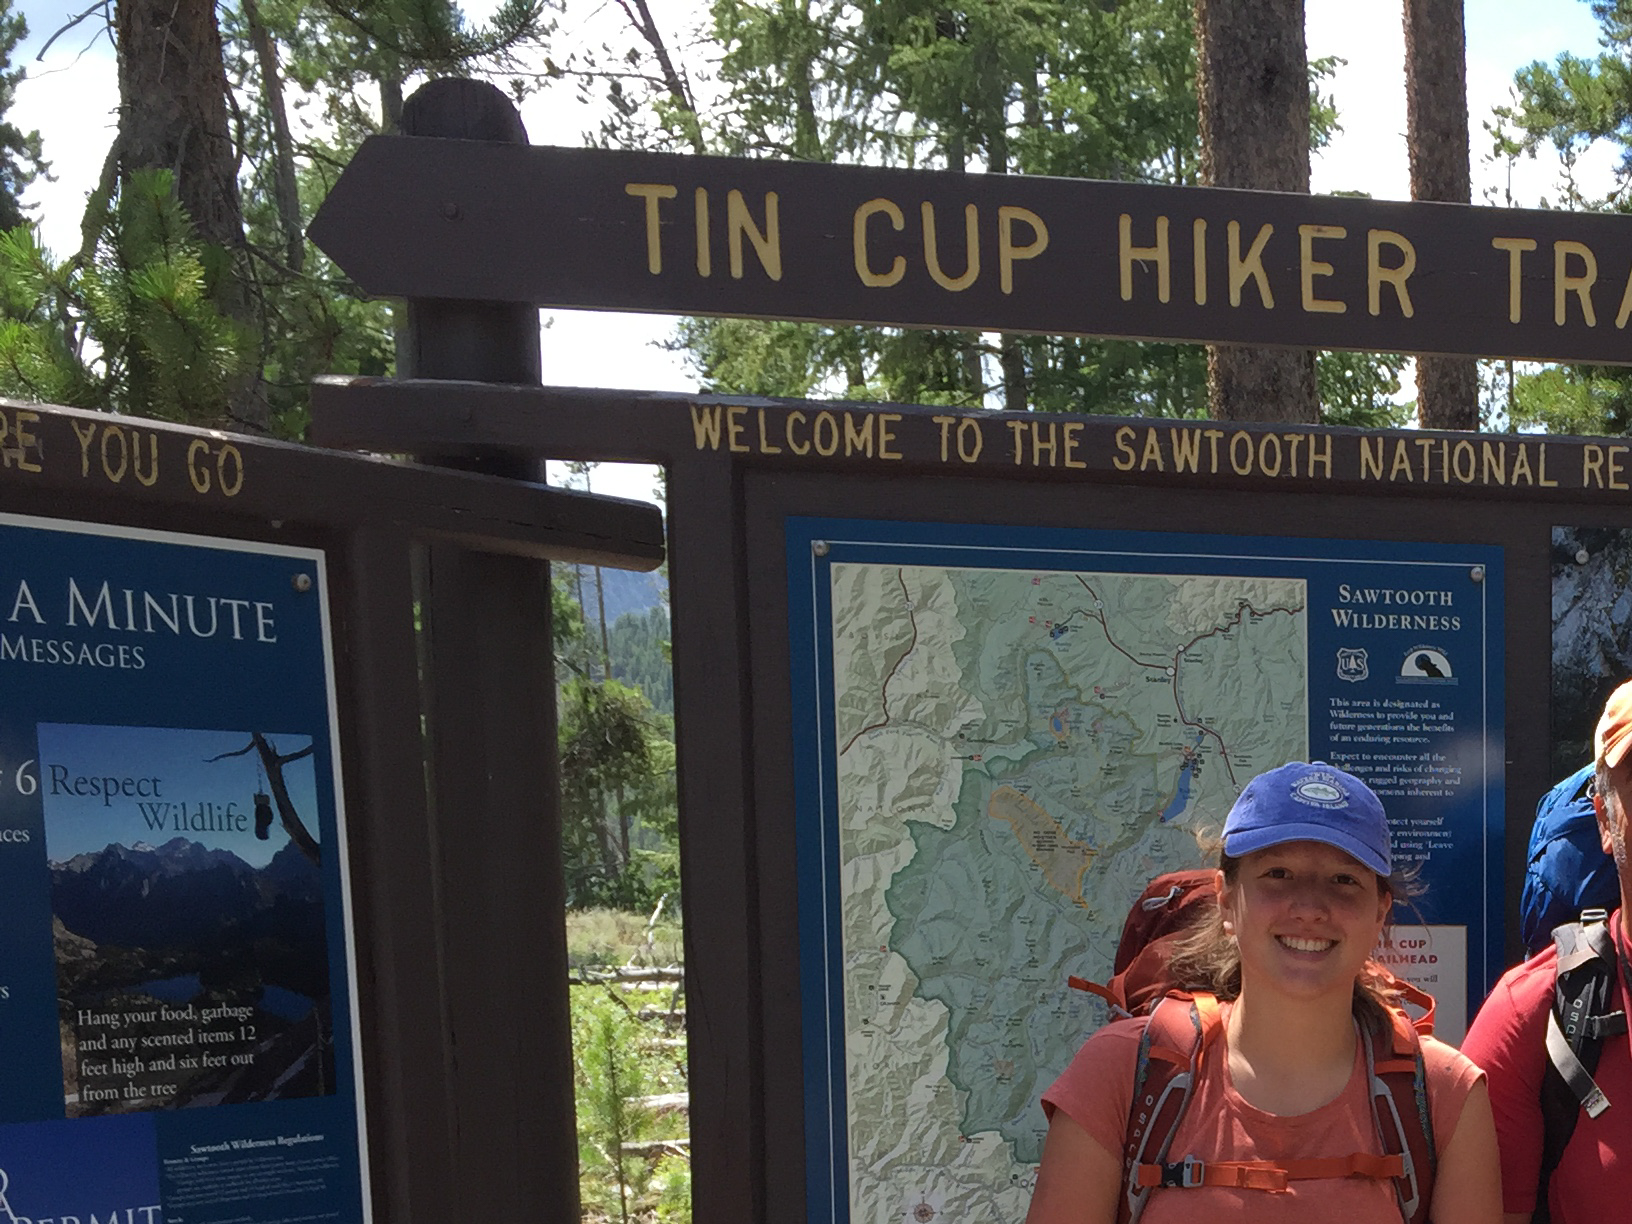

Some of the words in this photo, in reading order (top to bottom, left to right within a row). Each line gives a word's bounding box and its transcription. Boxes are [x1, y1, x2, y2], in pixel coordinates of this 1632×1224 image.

[625, 182, 783, 281] TIN
[852, 198, 1049, 295] CUP
[1119, 213, 1418, 318] HIKER
[71, 418, 159, 487] YOU
[188, 438, 245, 496] GO
[690, 405, 904, 462] WELCOME
[932, 415, 984, 464] TO
[1005, 419, 1087, 470] THE
[1112, 426, 1333, 480] SAWTOOTH
[1359, 436, 1558, 488] NATIONAL
[1338, 583, 1453, 606] SAWTOOTH
[7, 579, 46, 625] A
[66, 576, 278, 644] MINUTE
[1331, 608, 1461, 631] WILDERNESS
[0, 633, 146, 670] MESSAGES
[15, 759, 37, 796] 6
[48, 764, 163, 807] Respect
[136, 801, 249, 833] Wildlife
[1377, 954, 1438, 964] AILHEAD
[1399, 939, 1427, 949] CUP
[78, 1009, 120, 1030] Hang
[123, 1010, 157, 1029] your
[160, 1004, 198, 1022] food,
[201, 1001, 254, 1024] garbage
[79, 1032, 107, 1052] and
[111, 1036, 138, 1054] any
[141, 1027, 194, 1048] scented
[198, 1028, 236, 1045] items
[239, 1025, 257, 1041] 12
[81, 1058, 108, 1077] feet
[112, 1055, 146, 1078] high
[149, 1054, 176, 1072] and
[179, 1054, 199, 1070] six
[202, 1050, 228, 1068] feet
[230, 1052, 256, 1067] out
[82, 1083, 120, 1102] from
[123, 1081, 147, 1099] the
[150, 1081, 179, 1097] tree
